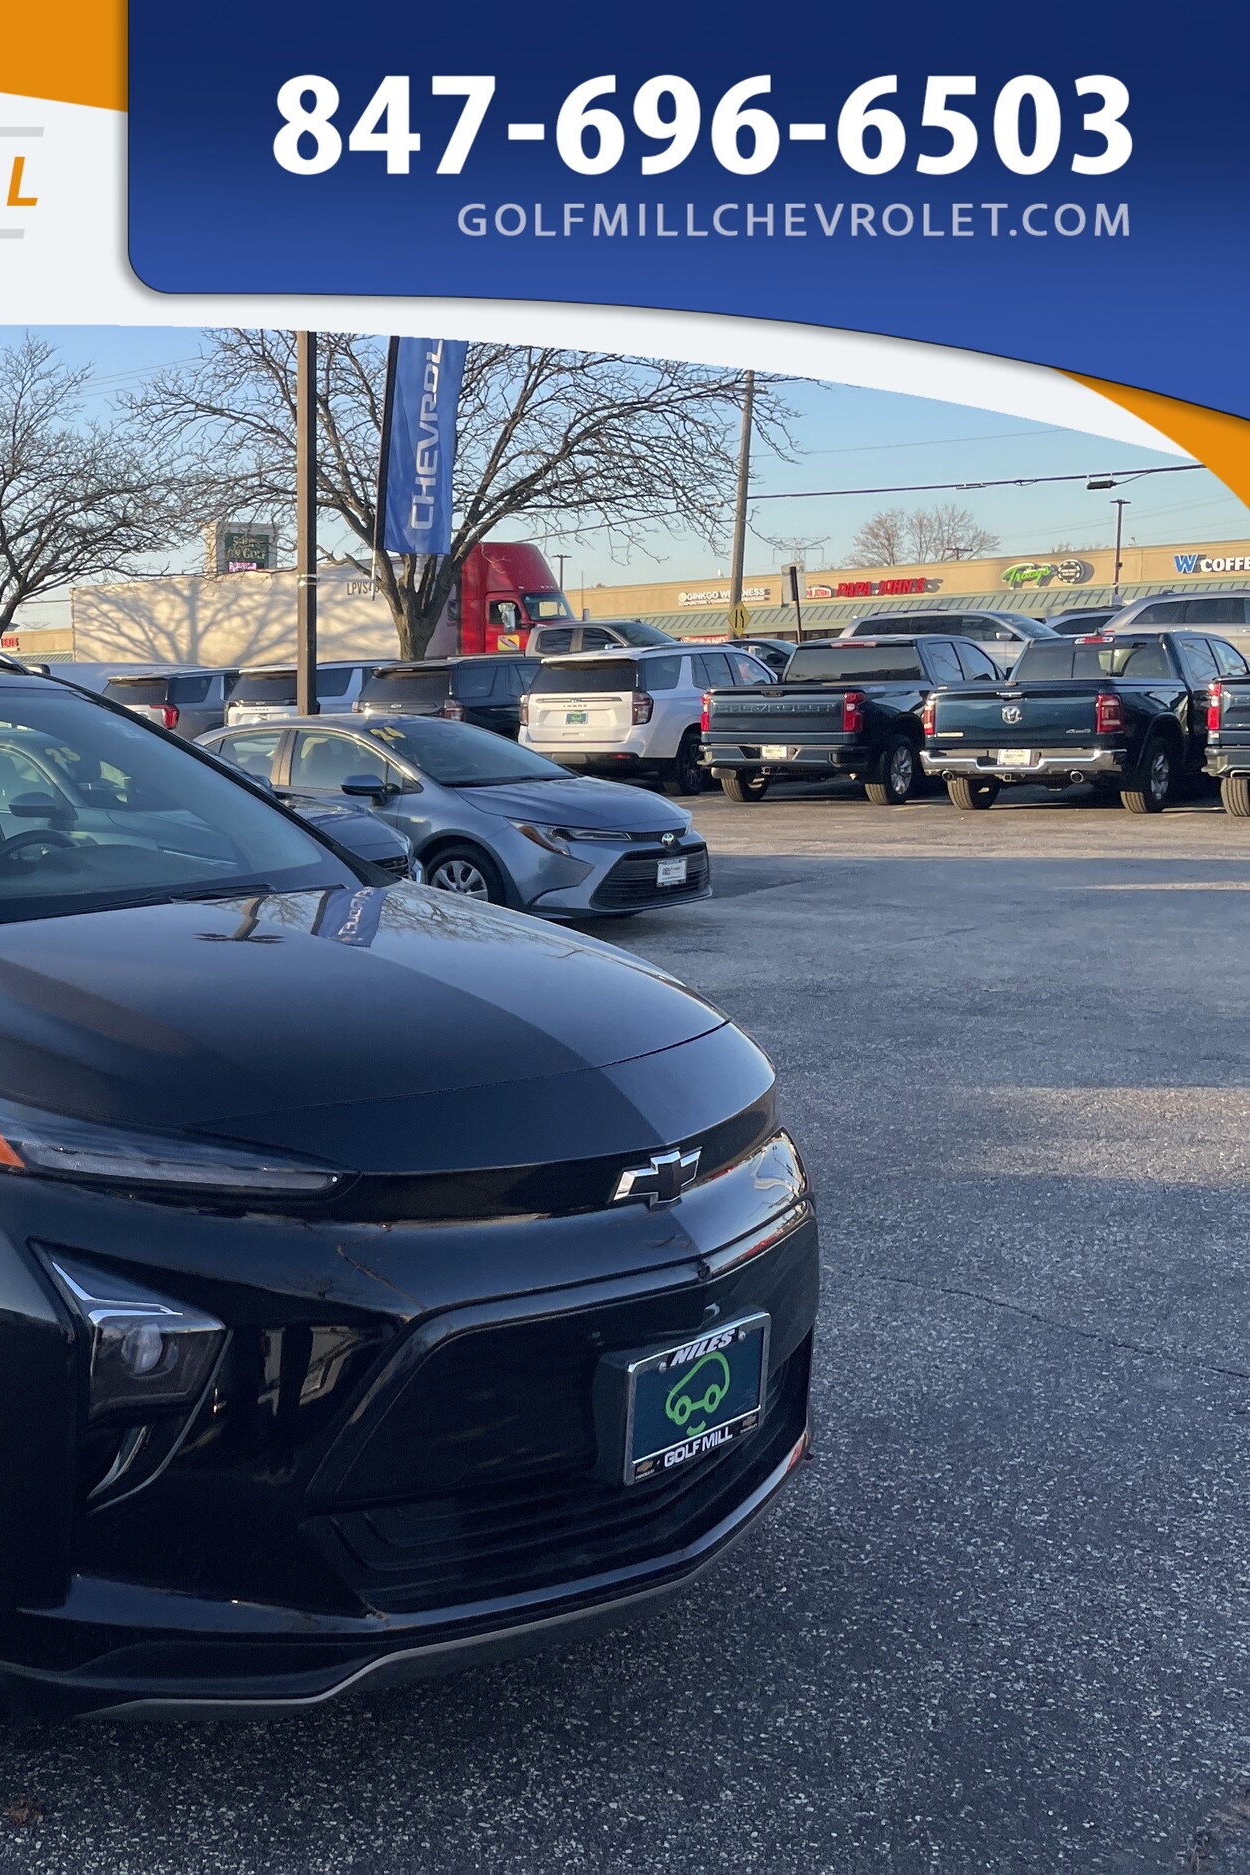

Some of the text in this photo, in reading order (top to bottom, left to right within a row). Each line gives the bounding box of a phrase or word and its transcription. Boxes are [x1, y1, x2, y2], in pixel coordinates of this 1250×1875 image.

[686, 590, 719, 601] GINKGO
[836, 577, 927, 598] PAPA JOHN'S
[670, 1328, 736, 1367] NILES
[664, 1442, 702, 1469] GOLF
[702, 1427, 733, 1452] MILL
